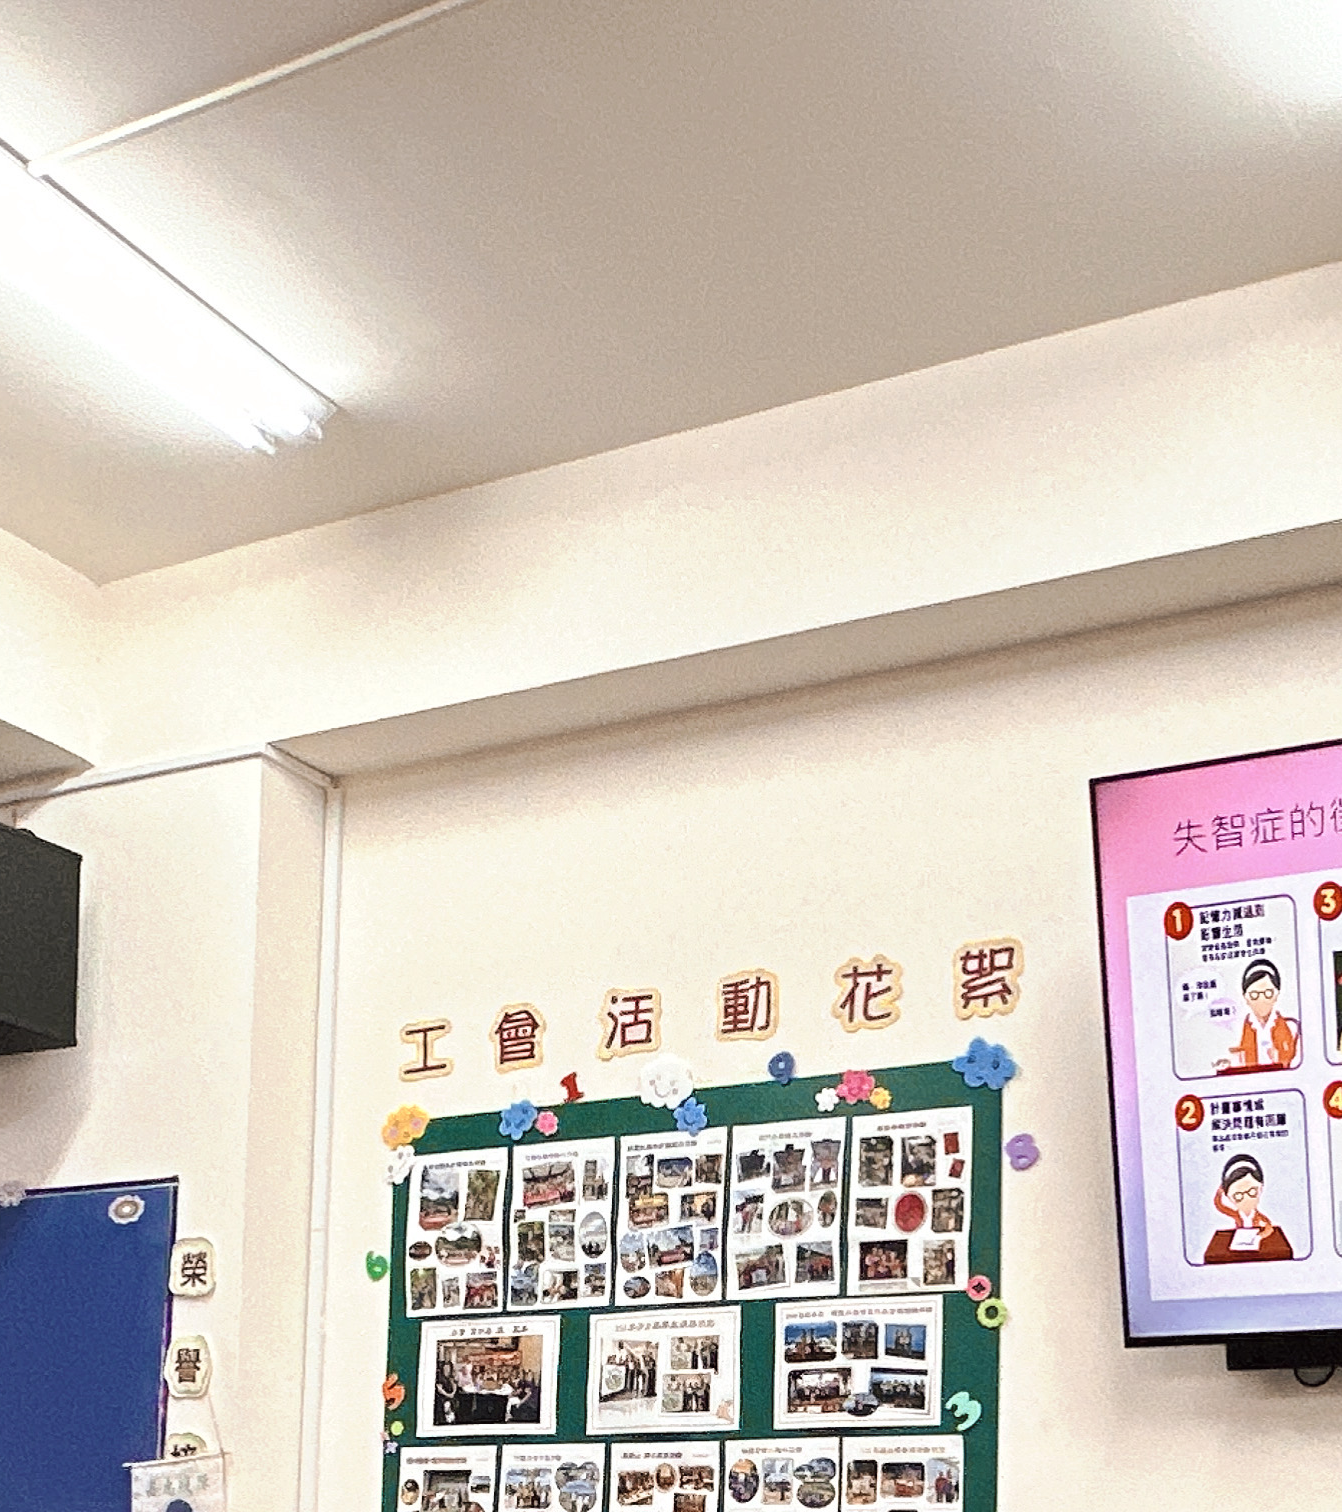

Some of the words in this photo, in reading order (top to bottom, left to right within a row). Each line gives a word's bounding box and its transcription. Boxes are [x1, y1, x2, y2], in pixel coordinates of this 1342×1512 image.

[1321, 889, 1338, 914] 3
[402, 946, 1015, 1076] 工會活動花絮
[1180, 1101, 1197, 1124] 2
